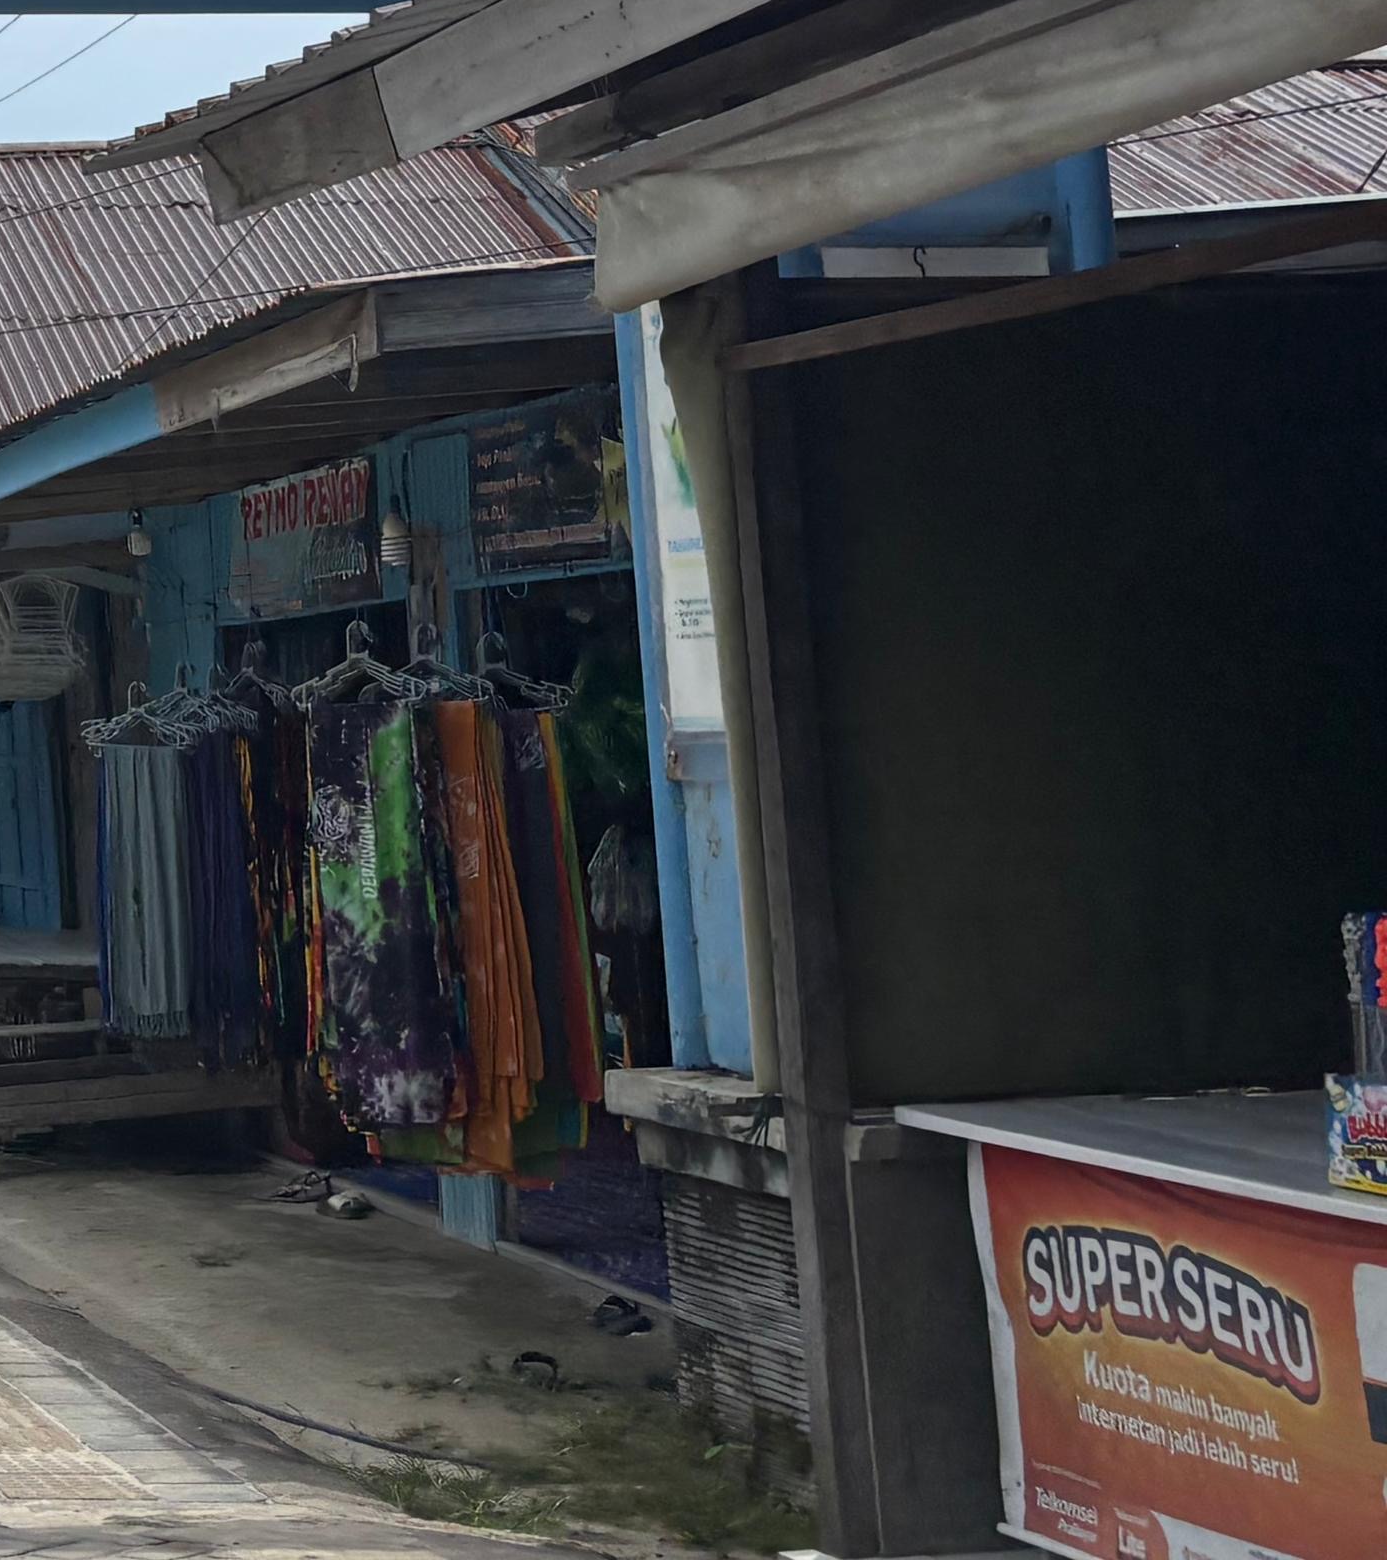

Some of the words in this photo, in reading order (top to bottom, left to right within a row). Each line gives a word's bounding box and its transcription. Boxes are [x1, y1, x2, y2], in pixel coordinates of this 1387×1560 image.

[1025, 1234, 1170, 1324] SUPER
[1172, 1254, 1314, 1384] SERU
[1077, 1395, 1168, 1448] internetan
[1168, 1422, 1200, 1455] jadi
[1202, 1432, 1248, 1469] lebih
[1250, 1455, 1300, 1485] seru!
[1082, 1349, 1150, 1399] Kuota
[1155, 1383, 1210, 1421] makin
[1211, 1393, 1280, 1442] banyak
[1035, 1486, 1097, 1525] Telkomsel
